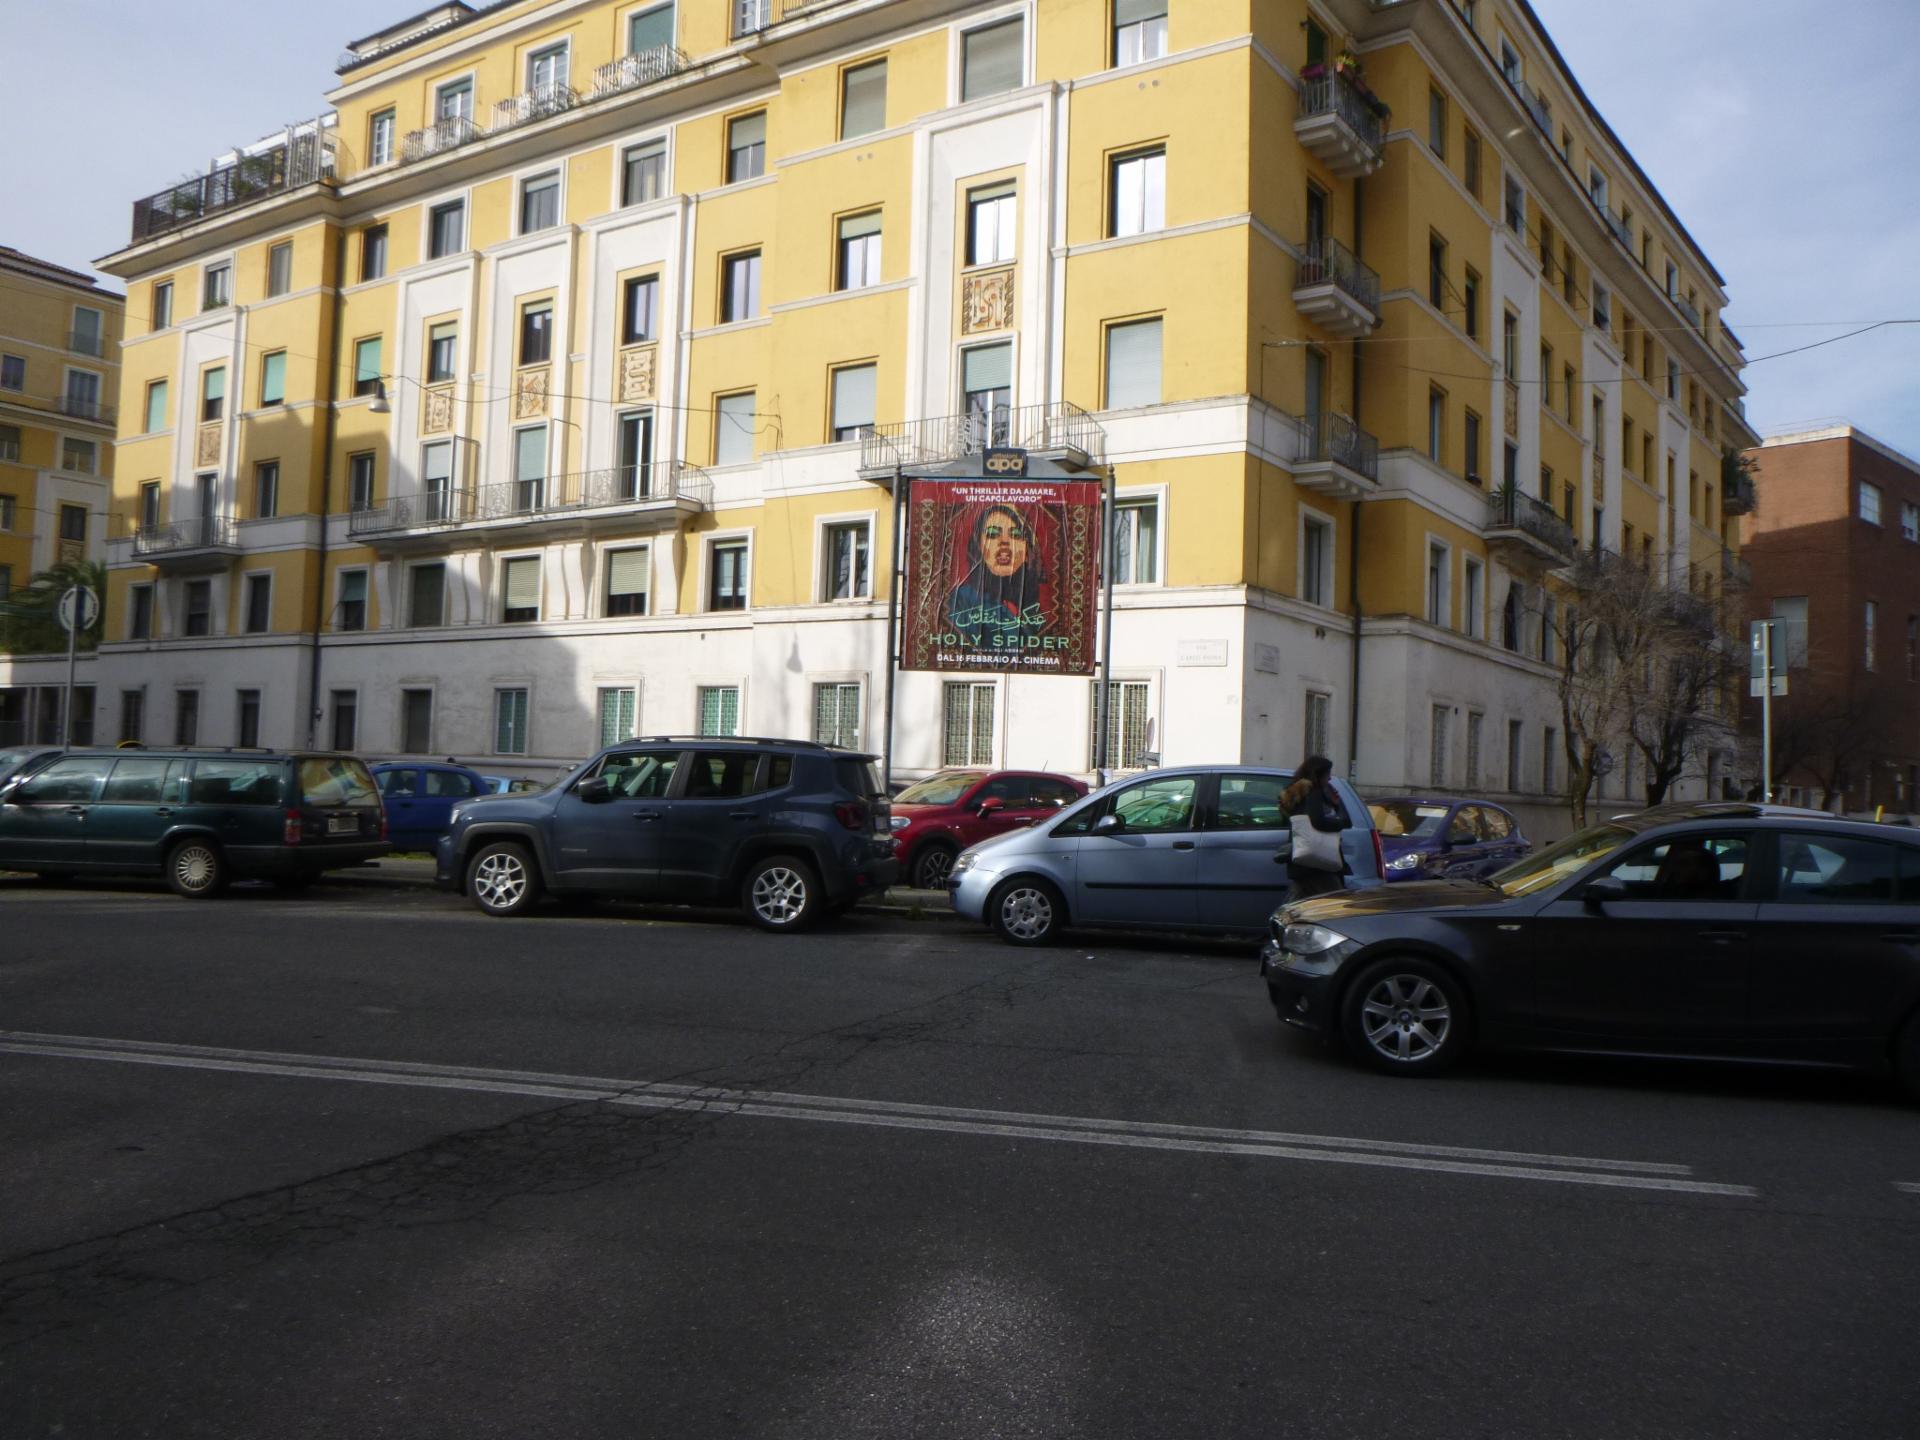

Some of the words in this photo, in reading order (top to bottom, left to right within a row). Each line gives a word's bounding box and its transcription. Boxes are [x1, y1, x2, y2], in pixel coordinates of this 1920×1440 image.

[970, 487, 1008, 495] THRILLER
[928, 633, 982, 646] HOLY
[993, 636, 1069, 649] SPIDER
[965, 656, 1010, 664] FEBBRAIO
[1024, 657, 1060, 665] CINEMA
